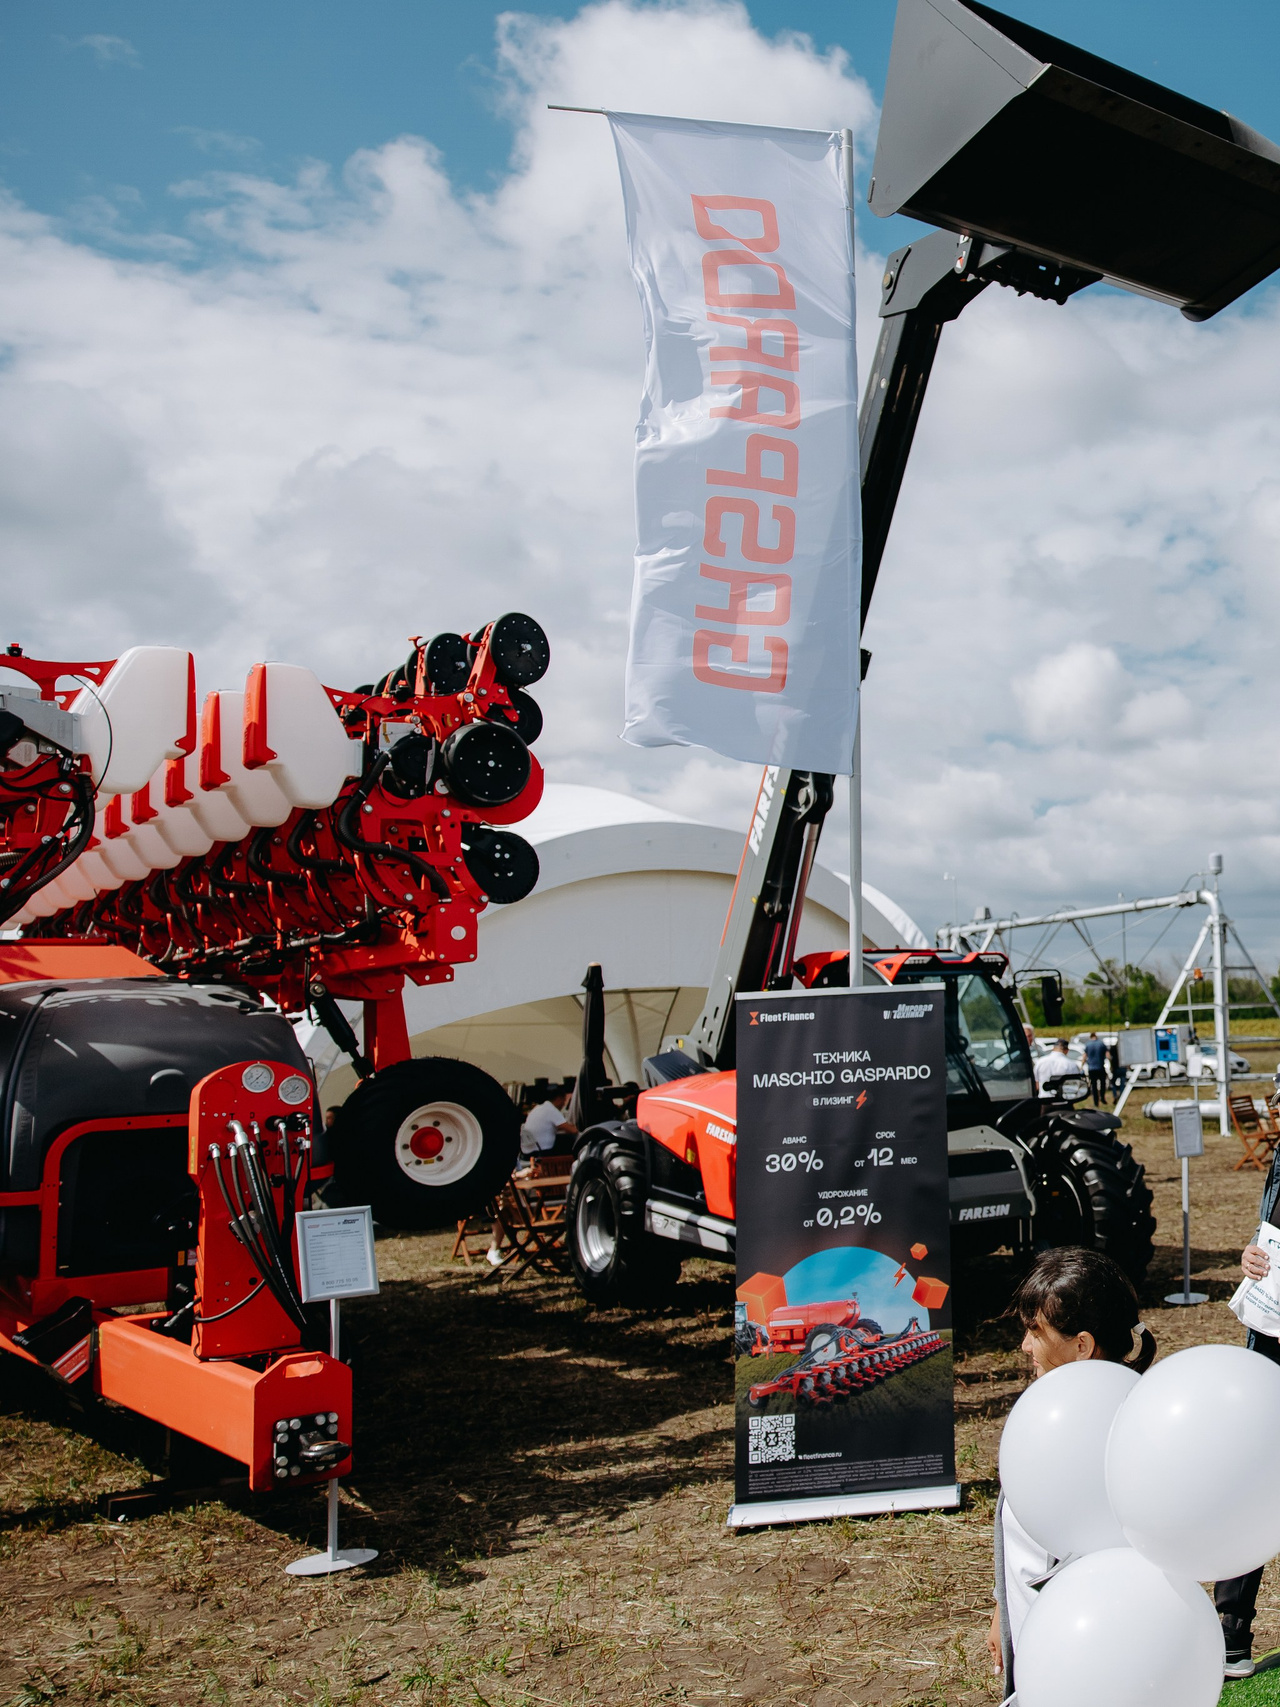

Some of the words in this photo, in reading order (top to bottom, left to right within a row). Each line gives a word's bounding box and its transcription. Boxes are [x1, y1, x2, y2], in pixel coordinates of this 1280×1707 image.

[760, 1013, 782, 1023] Fleet
[783, 1011, 815, 1022] Finance
[813, 1050, 871, 1065] ТЕХНИКА
[753, 1070, 835, 1089] MASCHIO
[840, 1064, 931, 1084] GASPARDO
[813, 1098, 819, 1106] В
[820, 1096, 854, 1106] ЛИЗИНГ
[782, 1135, 807, 1145] АВАНС
[875, 1131, 896, 1139] СРОК
[765, 1150, 824, 1173] 30%
[867, 1147, 894, 1167] 12
[900, 1157, 918, 1165] МЕС
[817, 1189, 869, 1199] УДОРОЖАНИЕ
[816, 1203, 882, 1229] 0,2%
[959, 1203, 1010, 1221] FARESIN
